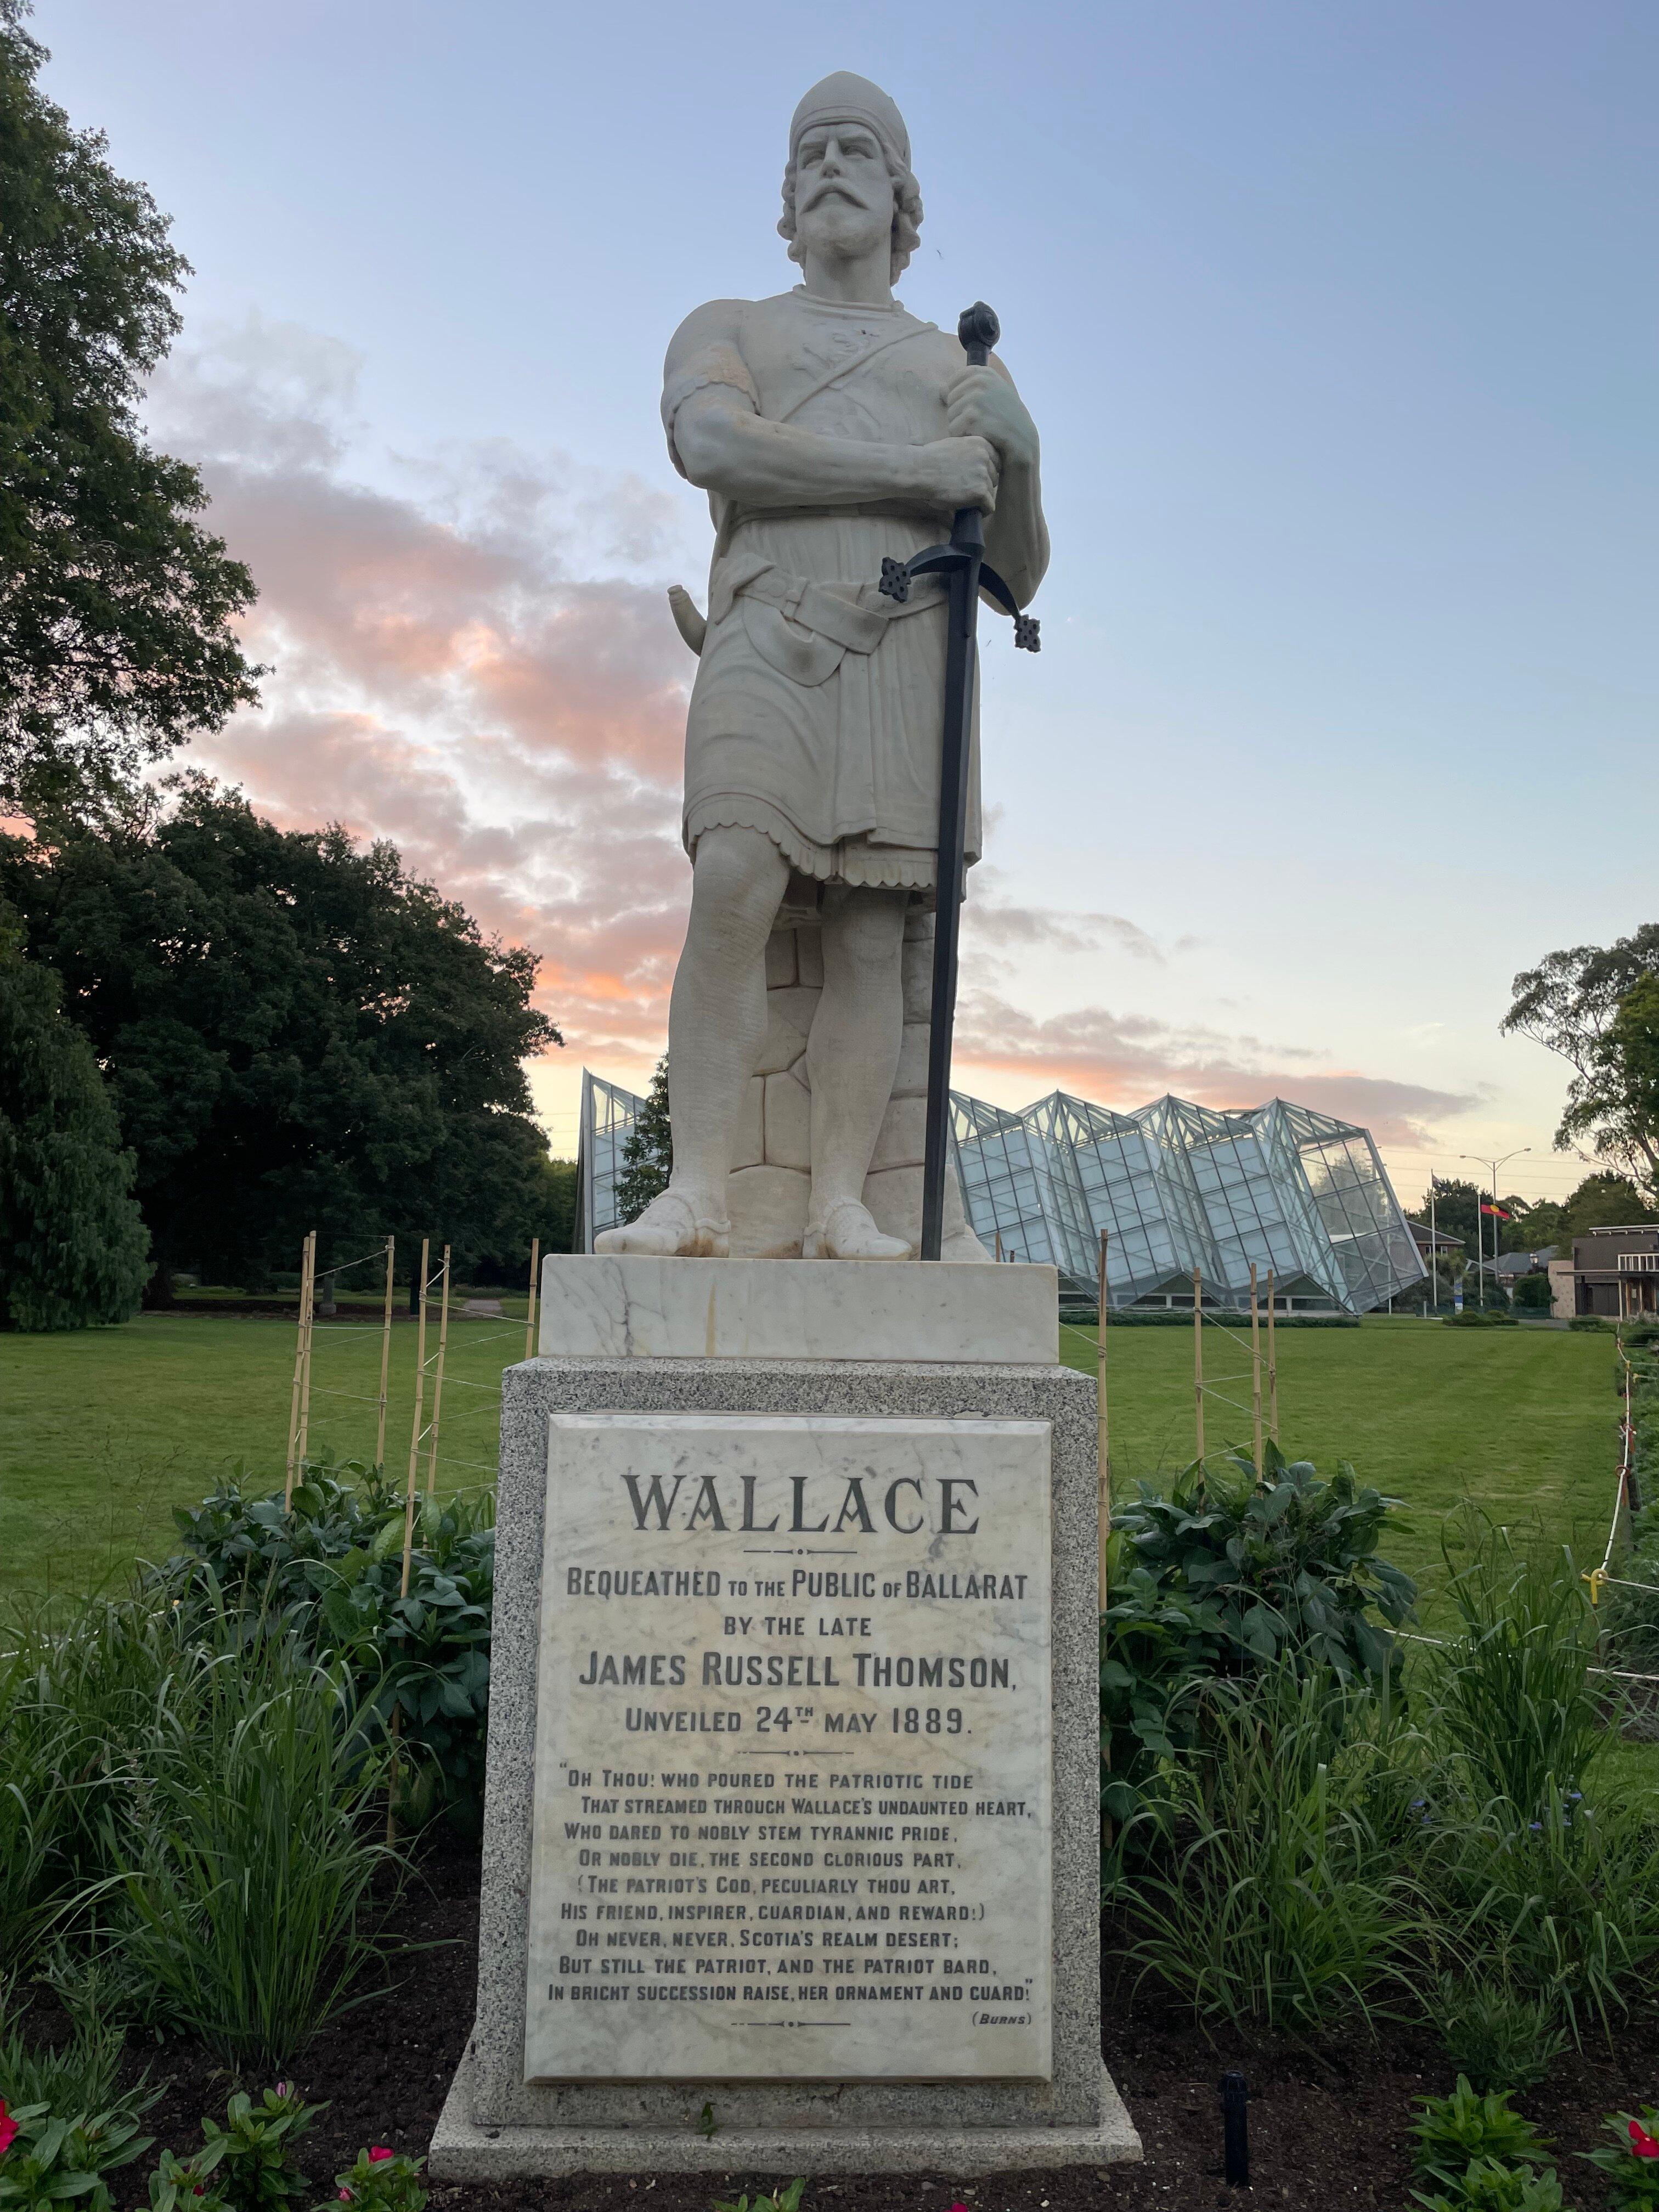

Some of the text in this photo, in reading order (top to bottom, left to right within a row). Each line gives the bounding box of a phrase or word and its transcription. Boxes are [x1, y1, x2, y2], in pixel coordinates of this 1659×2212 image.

[620, 1474, 980, 1535] WALLACE
[567, 1567, 1028, 1600] BEQUEATHED TO THE PUBLIC OF BALLARAT
[724, 1616, 872, 1637] BY THE LATE
[579, 1650, 686, 1686] JAMES
[702, 1651, 840, 1686] RUSSELL
[625, 1707, 741, 1733] UNVEILED
[825, 1713, 877, 1733] MAY
[893, 1707, 972, 1735] 1889.
[661, 1773, 699, 1788] WHO
[707, 1773, 775, 1788] POURED
[784, 1773, 819, 1788] THE
[830, 1774, 923, 1789] PATRIOTIC
[932, 1774, 974, 1790] TIDE
[581, 1796, 619, 1814] THAT
[624, 1799, 707, 1814] STREAMED
[878, 1801, 968, 1815] UNDAUNTED
[564, 1822, 601, 1839] WHO
[609, 1825, 661, 1840] DARED
[670, 1825, 690, 1840] TO
[698, 1825, 750, 1841] NOBLY
[758, 1825, 802, 1841] STEM
[810, 1826, 894, 1841] TYRANNIC
[579, 1849, 601, 1866] OR
[609, 1852, 661, 1866] NOBLY
[709, 1852, 740, 1867] THE
[749, 1852, 814, 1867] SECOND
[761, 1878, 858, 1894] PECULIARLY
[867, 1879, 910, 1894] THOU
[561, 1903, 588, 1920] HIS
[855, 1905, 890, 1920] AND
[575, 1929, 599, 1947] OH
[822, 1932, 878, 1947] REALM
[559, 1955, 592, 1974] BUT
[601, 1959, 645, 1974] STILL
[654, 1959, 686, 1974] THE
[777, 1959, 814, 1974] AND
[822, 1959, 855, 1974] THE
[864, 1959, 934, 1974] PATRIOT
[548, 1984, 564, 2001] IN
[637, 1985, 736, 2001] SUCCESSION
[798, 1985, 828, 2001] HER
[835, 1985, 924, 2001] ORNAMENT
[928, 1985, 963, 2001] AND
